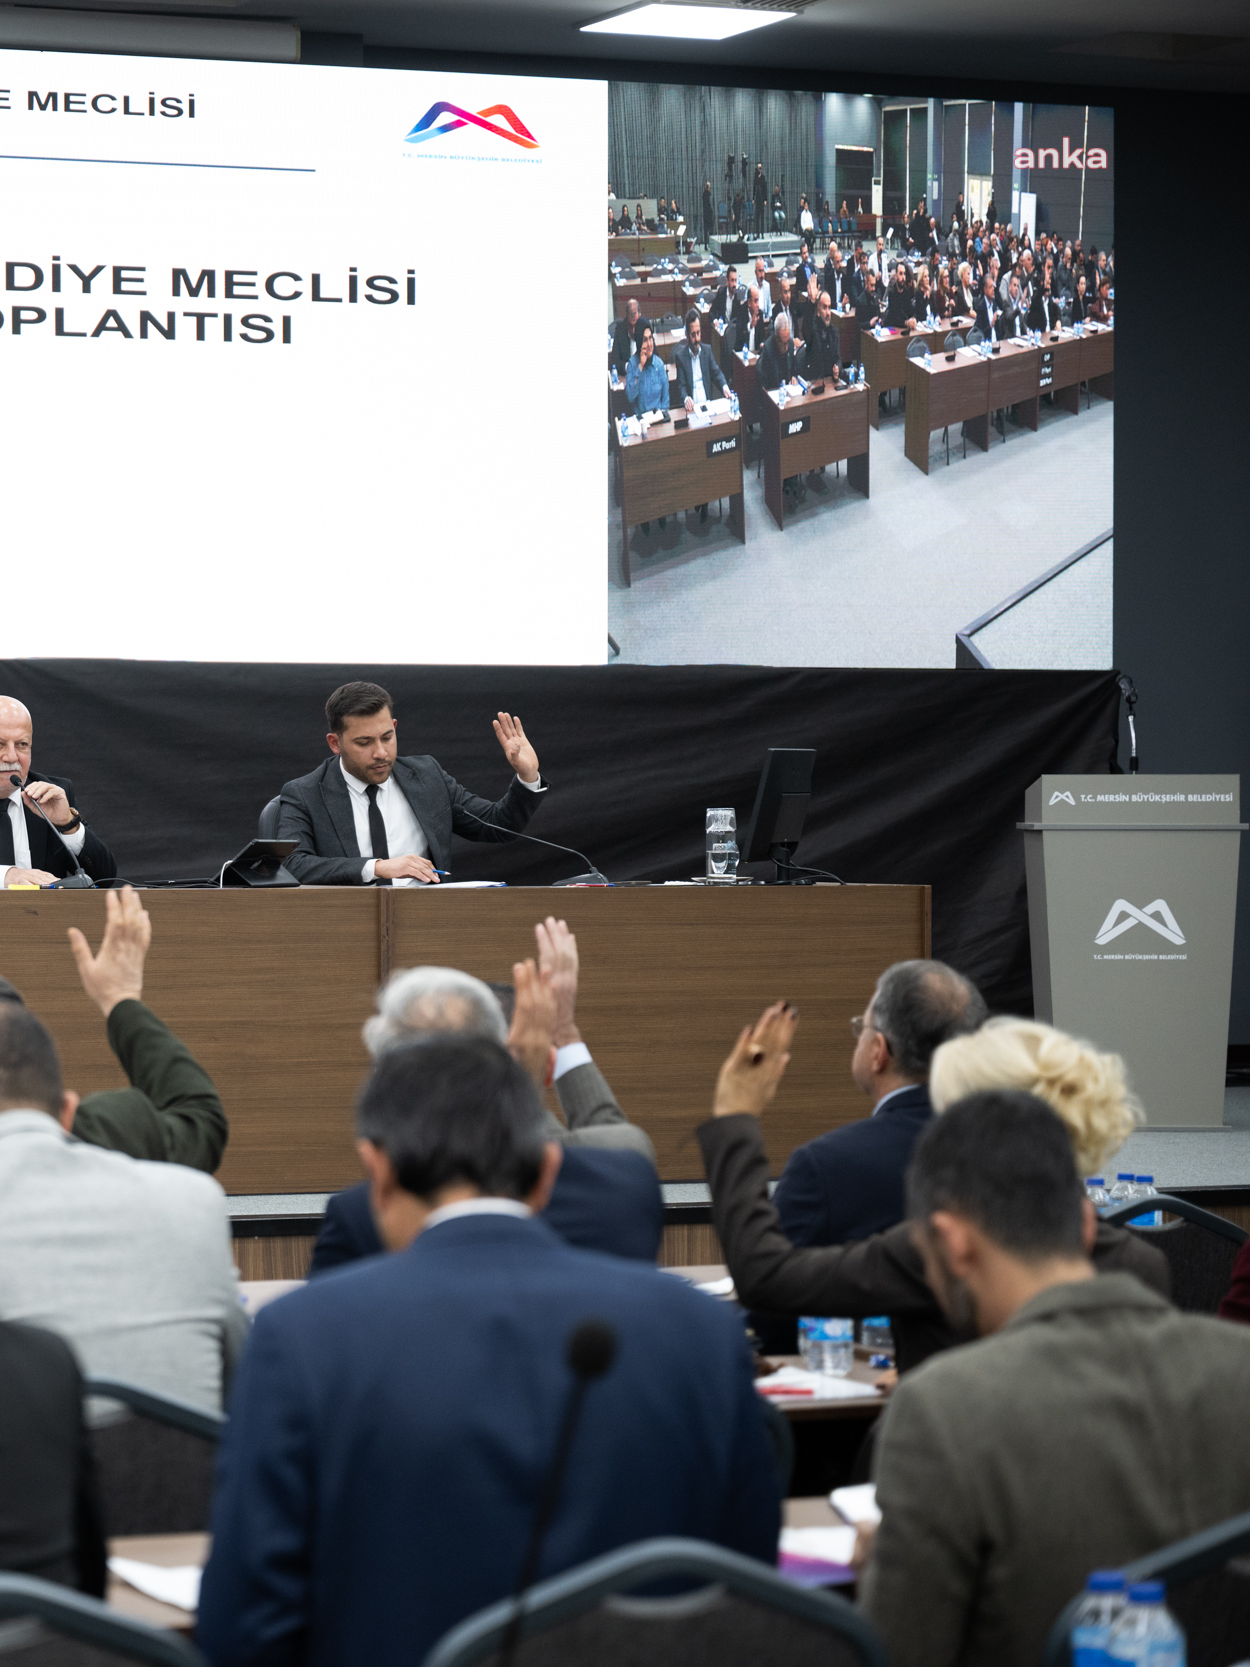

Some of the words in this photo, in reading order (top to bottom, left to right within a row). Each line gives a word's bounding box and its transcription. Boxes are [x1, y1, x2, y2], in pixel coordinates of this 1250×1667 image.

[27, 90, 195, 119] MECLİSİ
[171, 267, 416, 306] MECLİSİ
[712, 441, 722, 453] AK
[1080, 794, 1095, 802] T.C.
[1096, 792, 1129, 802] MERSİN
[1131, 792, 1186, 804] BÜYÜKŞEHİR
[1187, 792, 1233, 802] BELEDİYESİ
